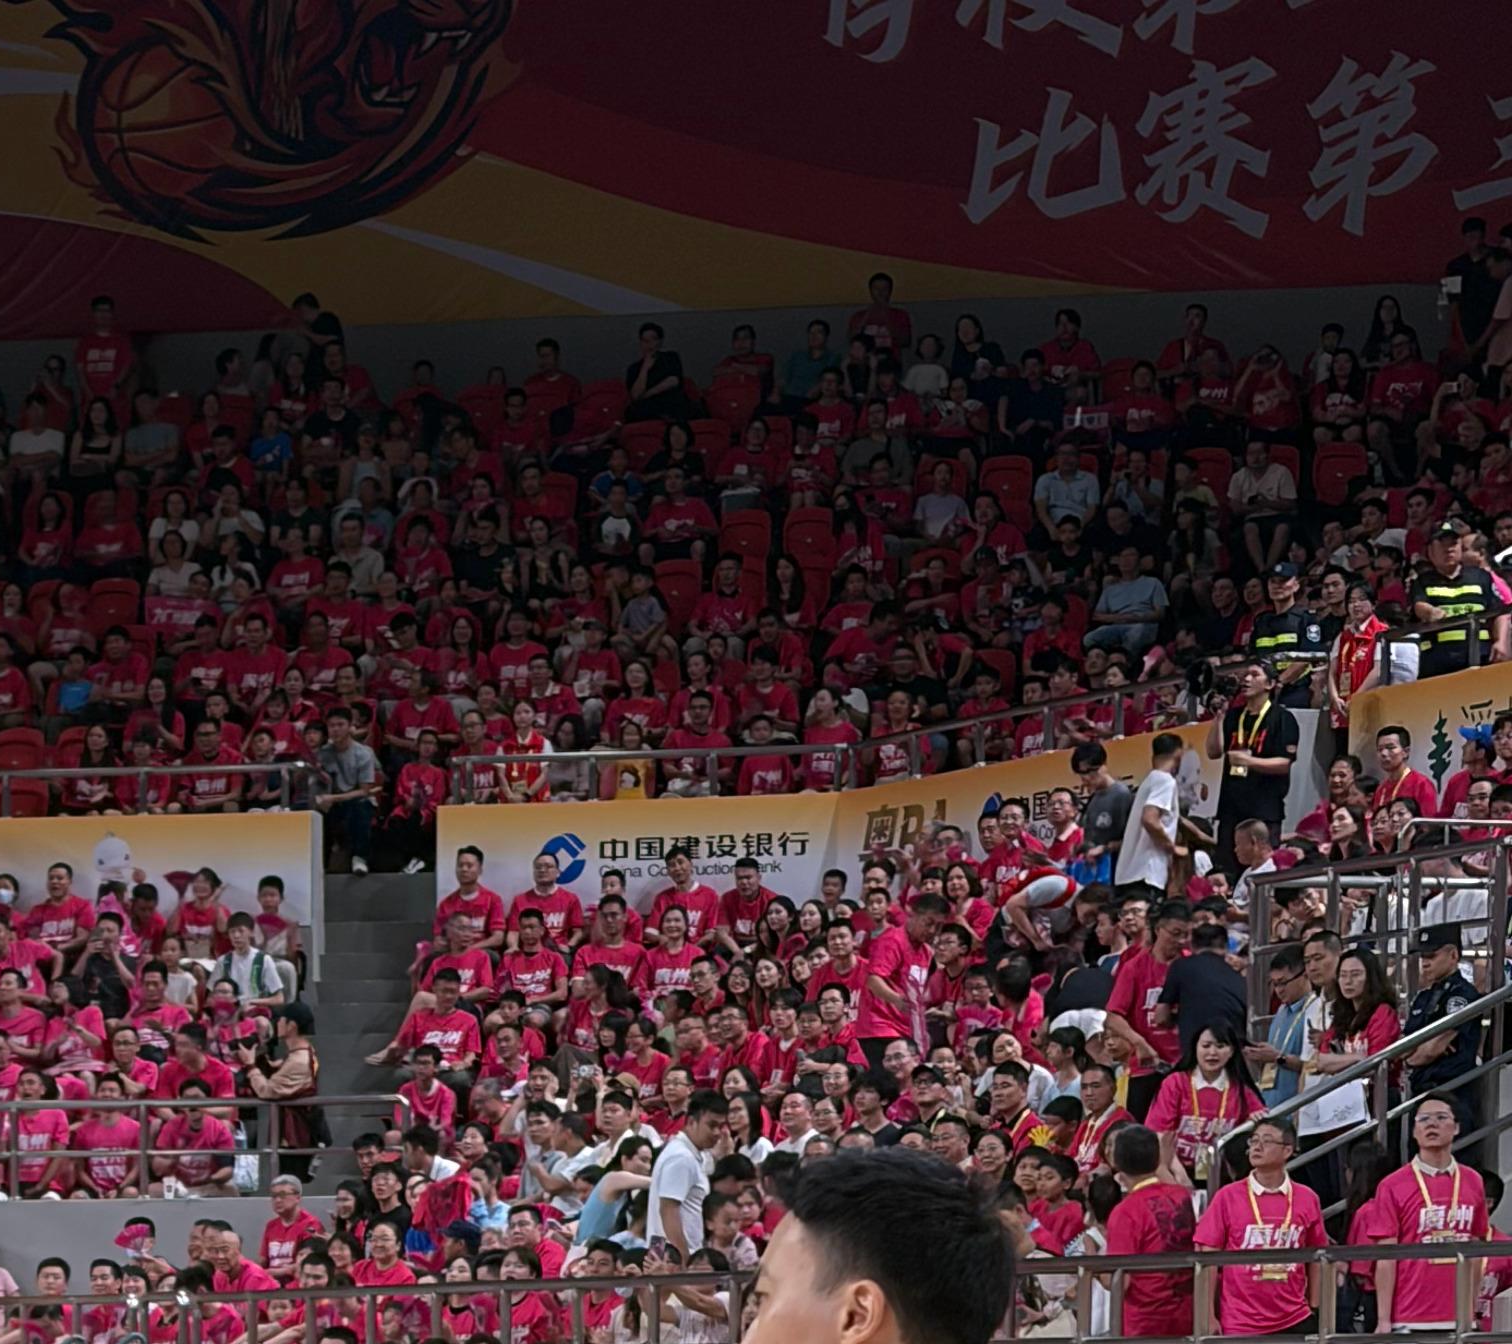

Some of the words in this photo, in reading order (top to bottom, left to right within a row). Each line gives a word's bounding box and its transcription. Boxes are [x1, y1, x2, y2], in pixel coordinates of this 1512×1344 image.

[599, 831, 810, 861] 中国建设银行
